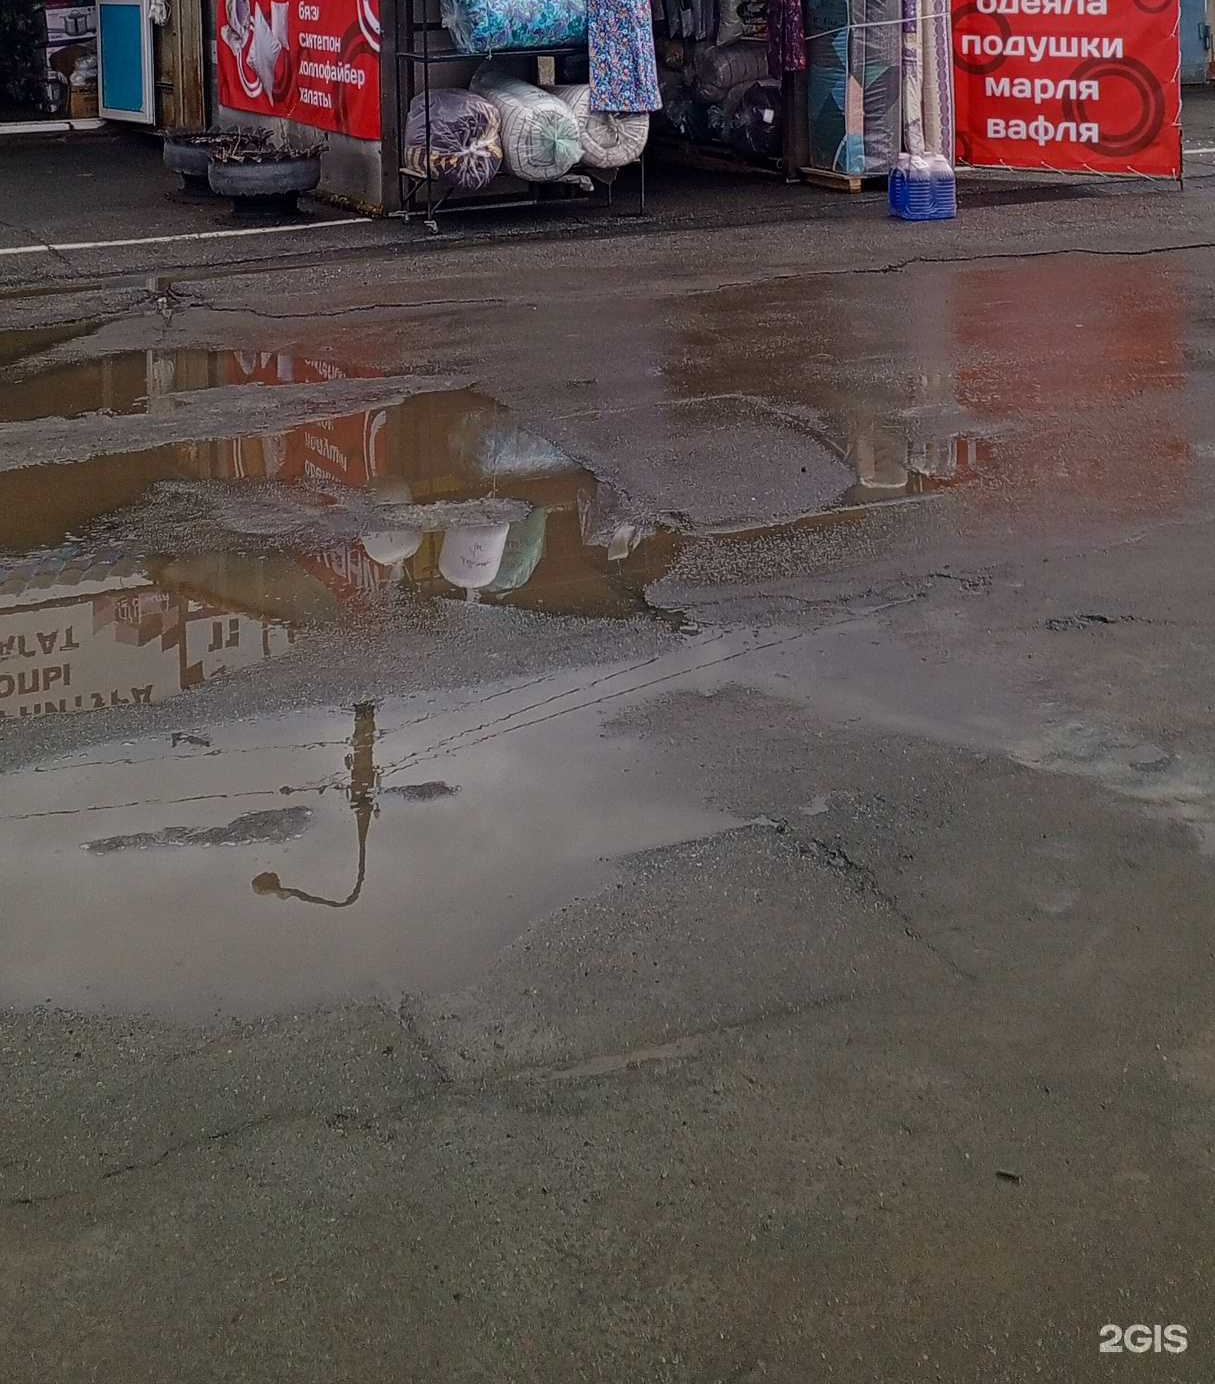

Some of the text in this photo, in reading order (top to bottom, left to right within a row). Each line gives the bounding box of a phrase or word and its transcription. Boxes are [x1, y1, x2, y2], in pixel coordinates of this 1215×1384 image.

[961, 34, 1124, 62] подушки
[985, 76, 1100, 104] марля
[987, 115, 1100, 146] вафля
